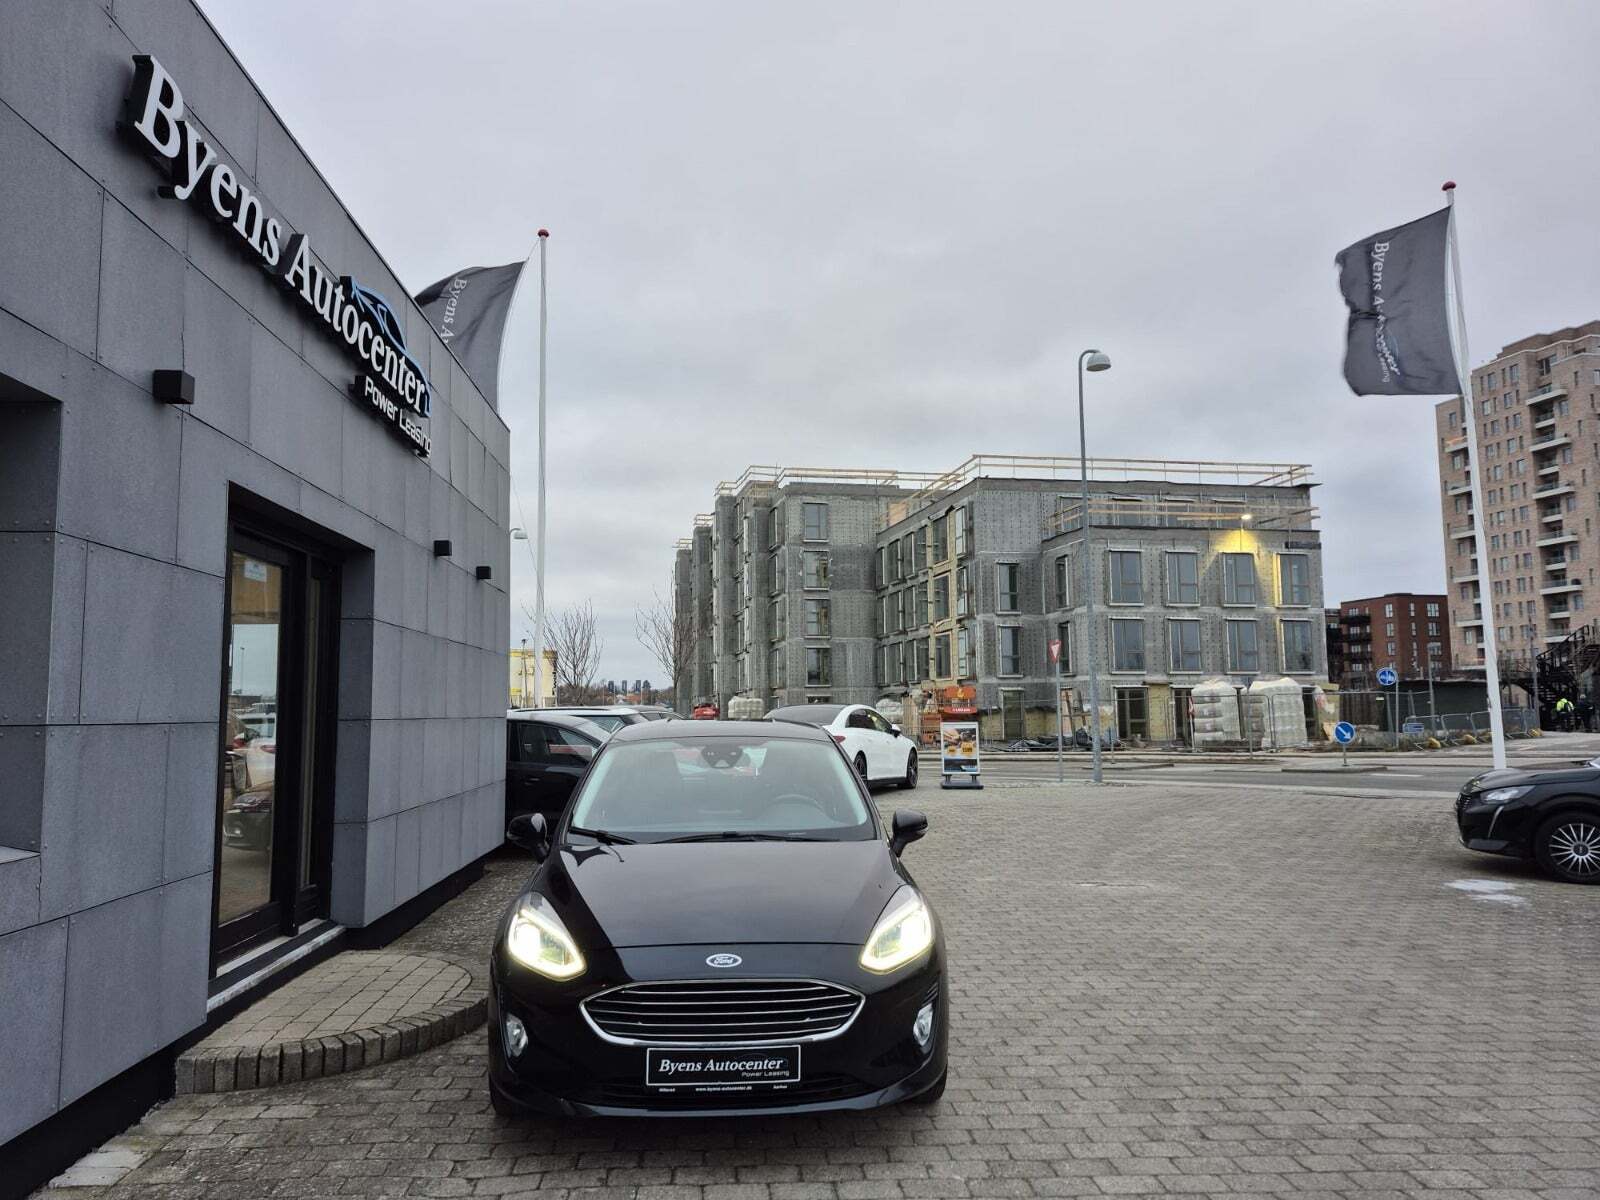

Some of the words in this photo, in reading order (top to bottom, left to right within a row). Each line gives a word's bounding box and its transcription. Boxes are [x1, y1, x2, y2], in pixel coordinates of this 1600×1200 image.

[137, 55, 282, 266] Byens
[285, 234, 425, 413] Autocenter
[1370, 242, 1390, 290] Byens
[443, 278, 468, 324] Byens
[365, 375, 398, 421] Power
[400, 408, 432, 458] Leasing
[658, 1059, 702, 1075] Byens
[704, 1058, 784, 1071] Autocenter
